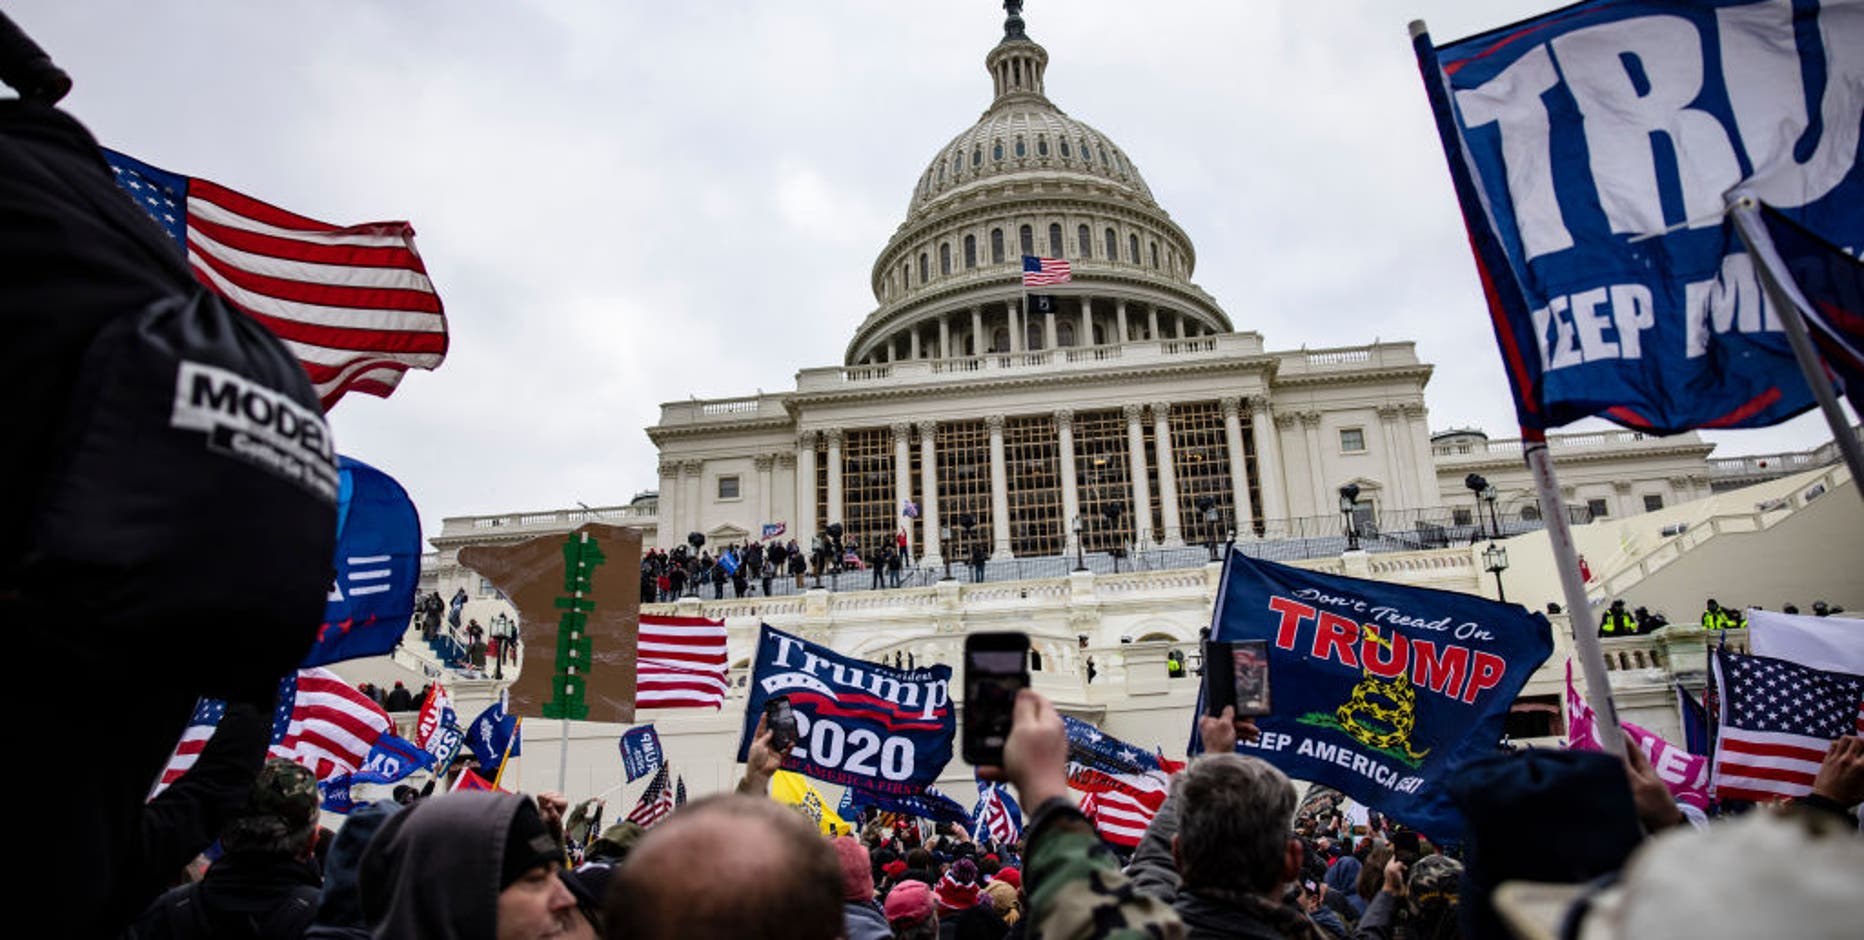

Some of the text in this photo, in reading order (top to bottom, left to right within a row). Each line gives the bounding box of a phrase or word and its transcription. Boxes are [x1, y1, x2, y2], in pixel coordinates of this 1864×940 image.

[1292, 587, 1495, 641] Don't Tread On
[768, 631, 948, 721] Trump
[1268, 595, 1507, 705] TRUMP
[803, 763, 874, 790] AMERICA
[1236, 731, 1292, 752] EEP
[1296, 738, 1399, 790] AMERICA
